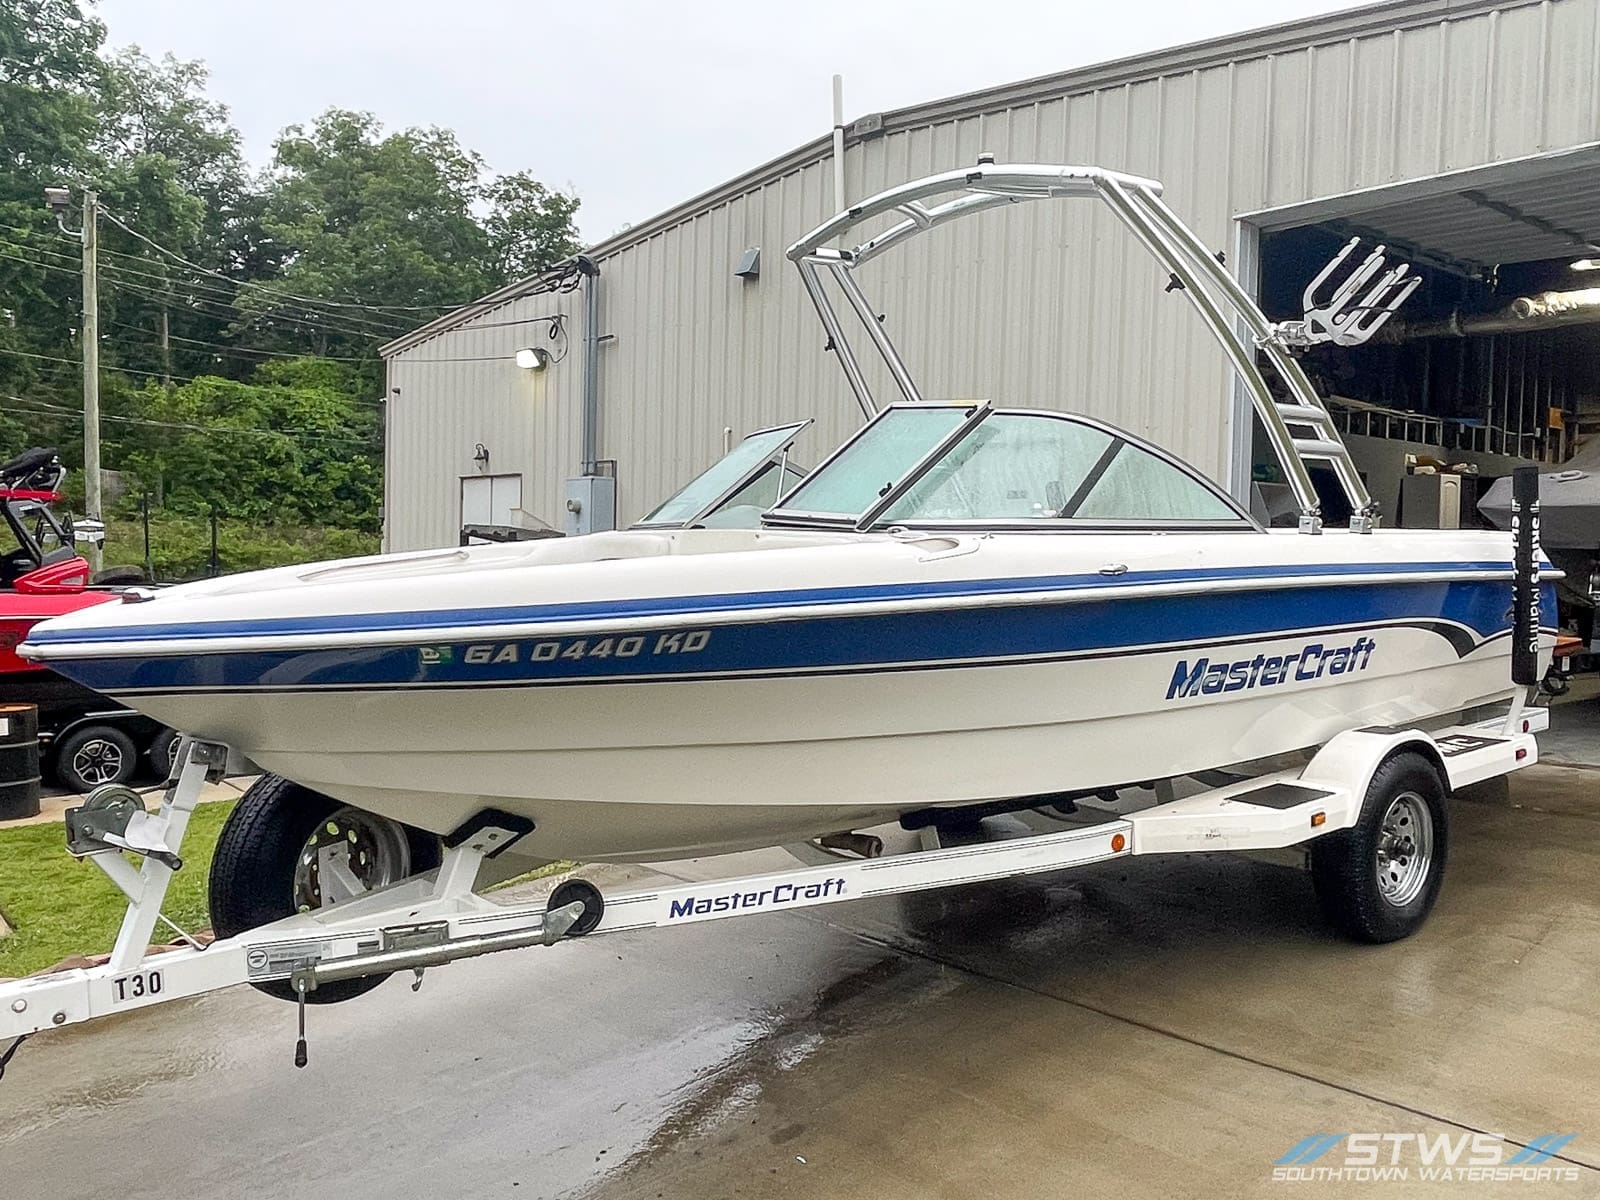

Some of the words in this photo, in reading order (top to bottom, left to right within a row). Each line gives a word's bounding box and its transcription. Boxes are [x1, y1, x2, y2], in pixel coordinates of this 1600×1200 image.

[464, 644, 519, 664] GA
[531, 636, 645, 661] 0440
[653, 630, 712, 655] KD
[1165, 636, 1376, 700] MasterCraft
[669, 878, 846, 918] MasterCraft
[113, 971, 162, 1000] T30
